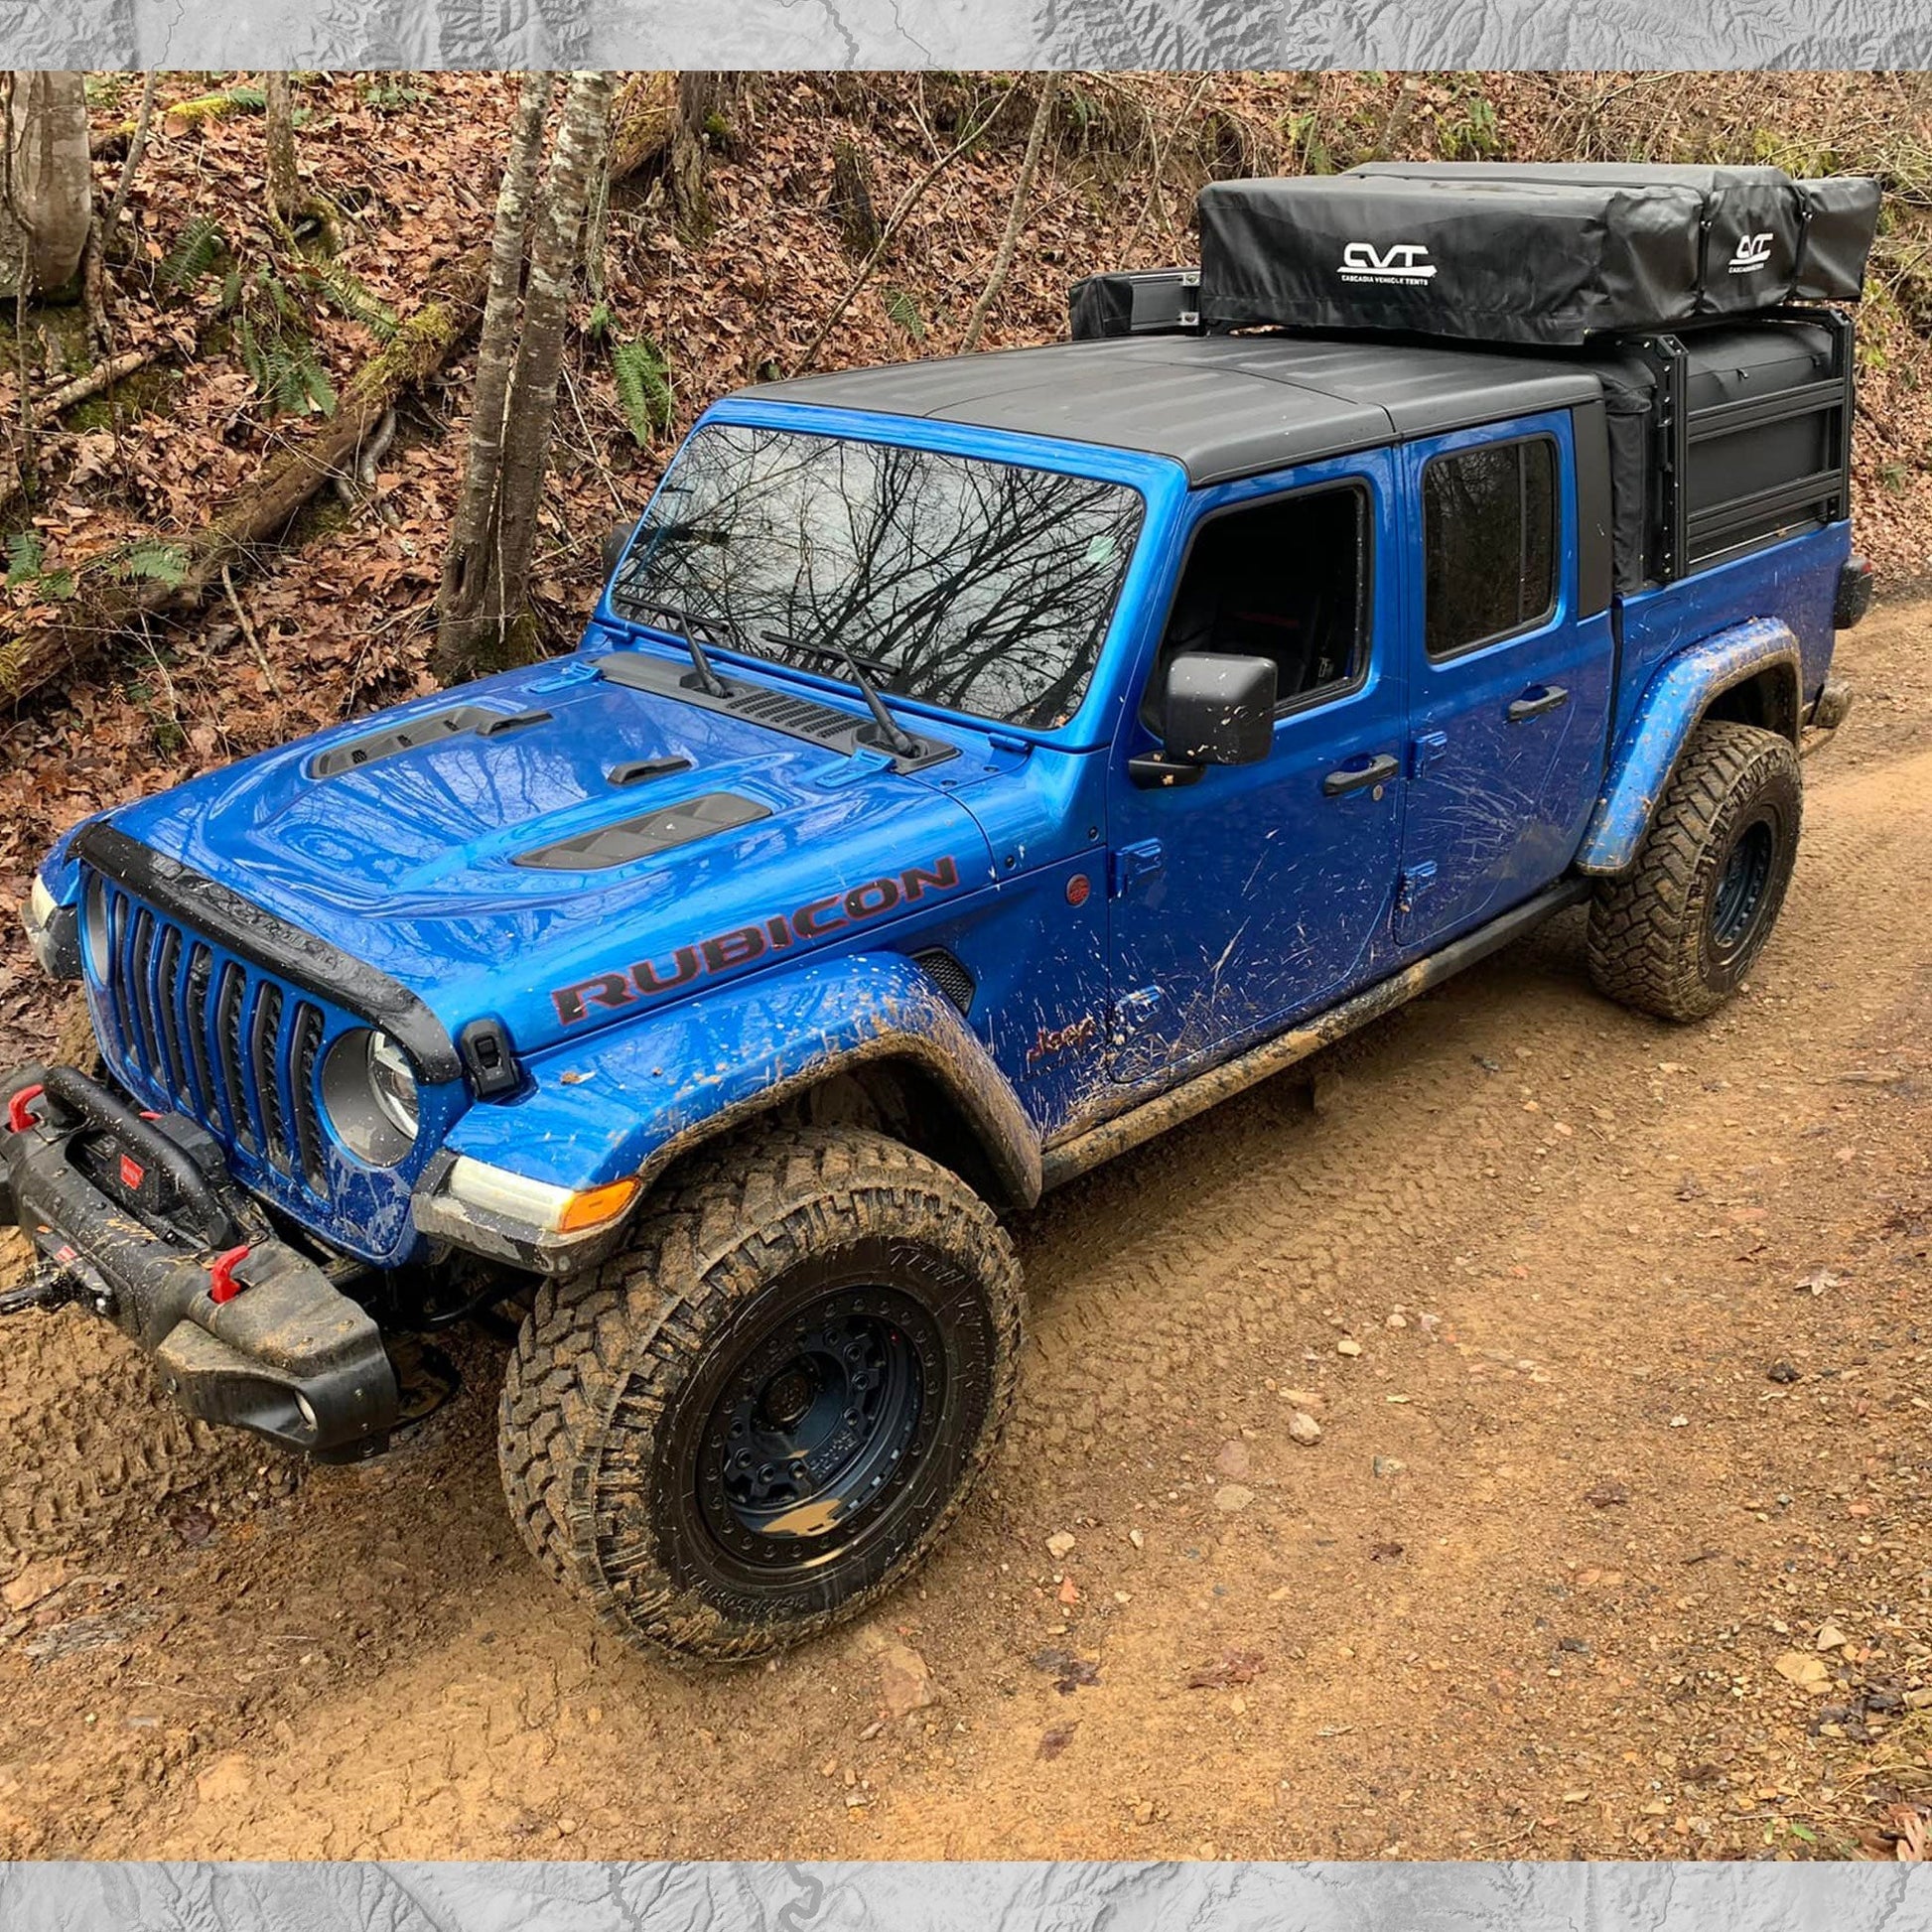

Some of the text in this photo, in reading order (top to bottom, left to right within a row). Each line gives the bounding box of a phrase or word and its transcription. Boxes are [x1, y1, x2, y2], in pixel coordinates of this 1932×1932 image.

[1343, 242, 1429, 268] CVT
[1736, 232, 1774, 259] CVT
[1341, 274, 1429, 286] CASCADIA VEHICLE TENTS
[551, 855, 960, 1026] RUBICON
